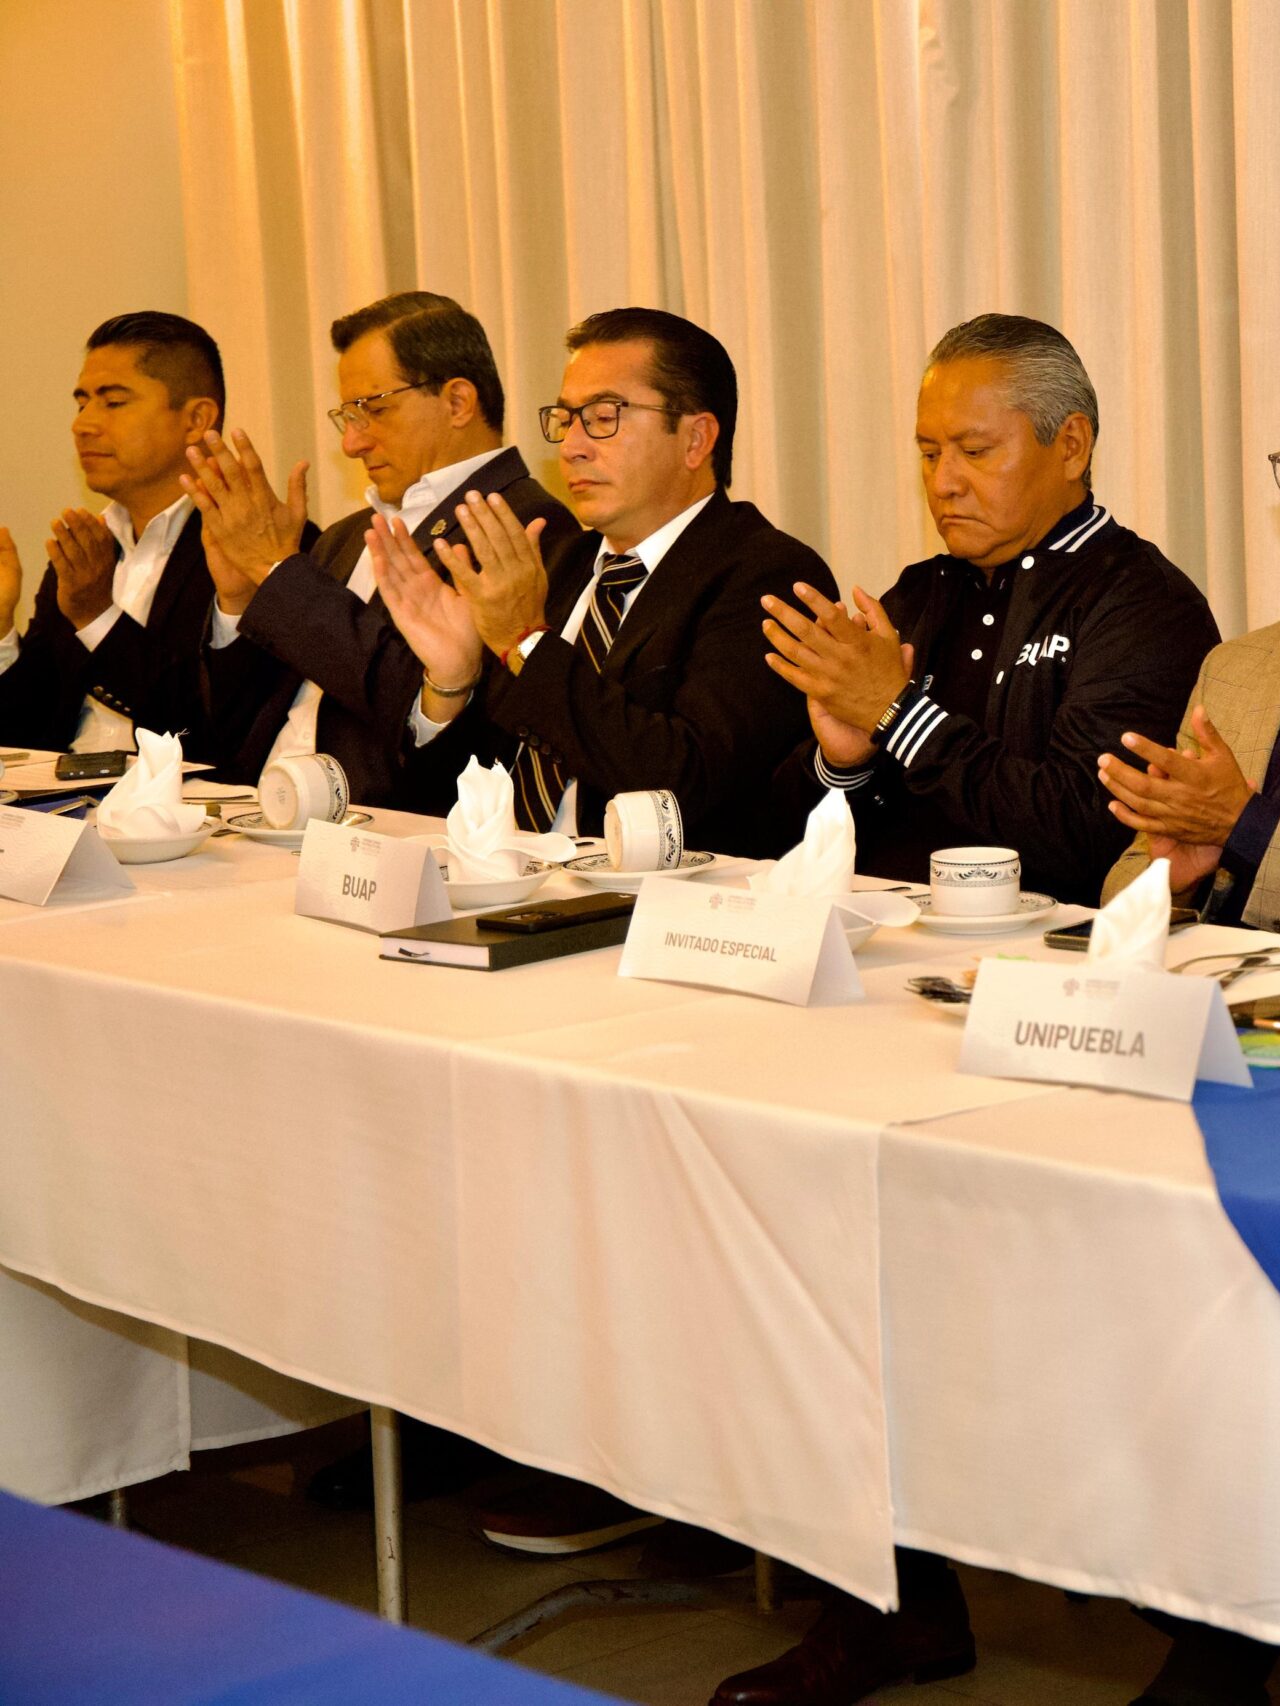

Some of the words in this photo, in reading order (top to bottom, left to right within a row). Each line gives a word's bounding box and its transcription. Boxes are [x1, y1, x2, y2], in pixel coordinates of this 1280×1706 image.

[342, 874, 377, 902] BUAP
[664, 931, 719, 953] INVITADO
[720, 940, 777, 962] ESPECIAL
[1014, 1020, 1145, 1058] UNIPUEBLA
